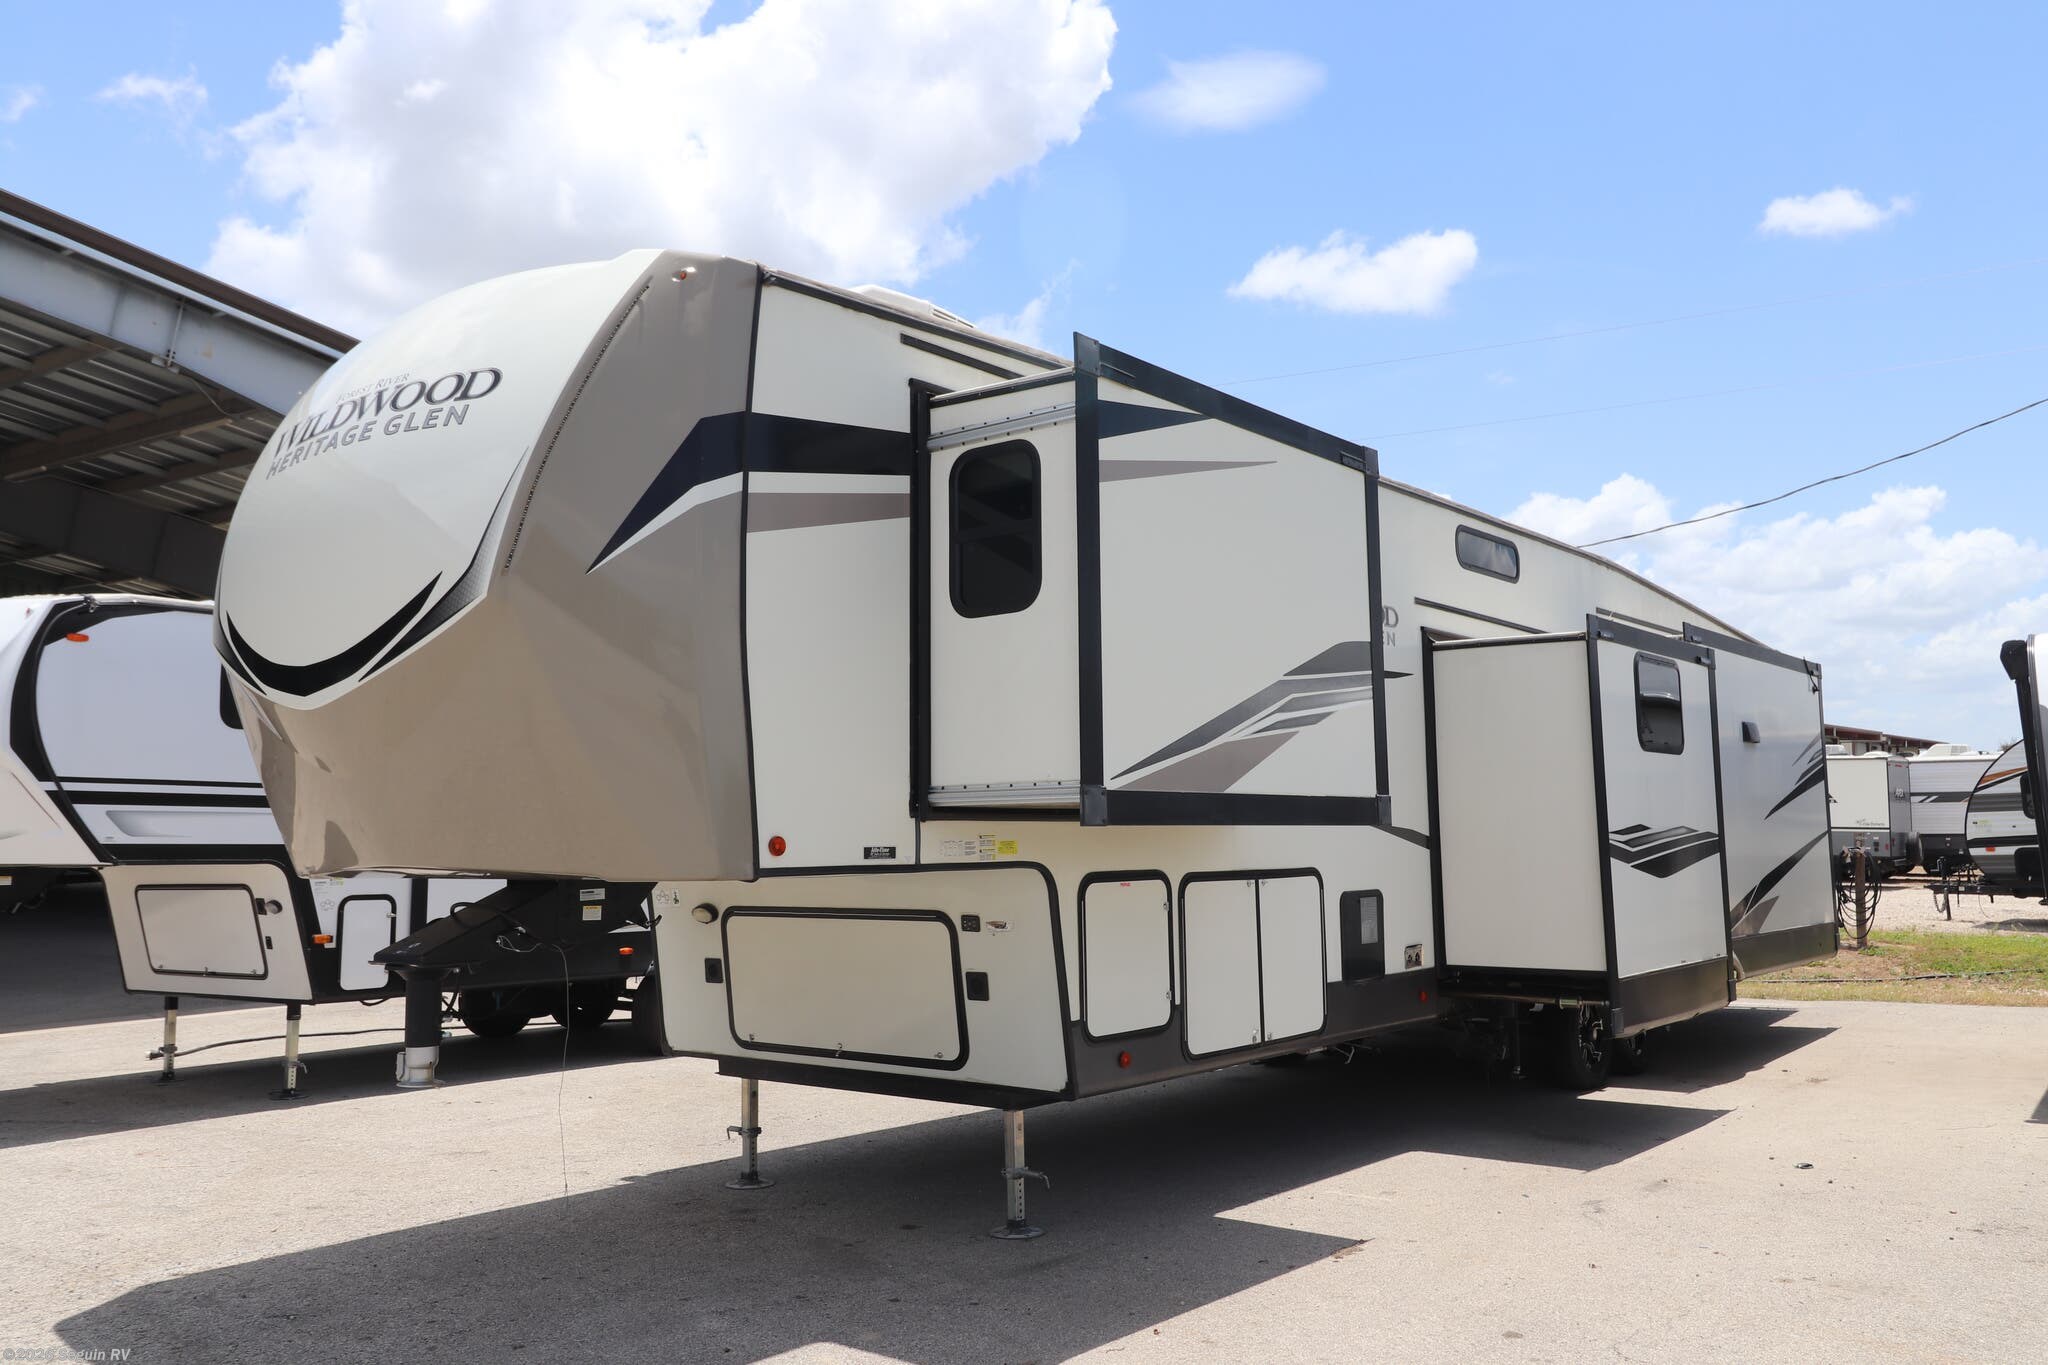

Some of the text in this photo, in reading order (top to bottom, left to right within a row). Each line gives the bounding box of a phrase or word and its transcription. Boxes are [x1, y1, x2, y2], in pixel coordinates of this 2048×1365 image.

[273, 367, 503, 459] WILDWOOD
[376, 373, 410, 390] RIVER
[265, 403, 470, 480] HERITAGE GLEN
